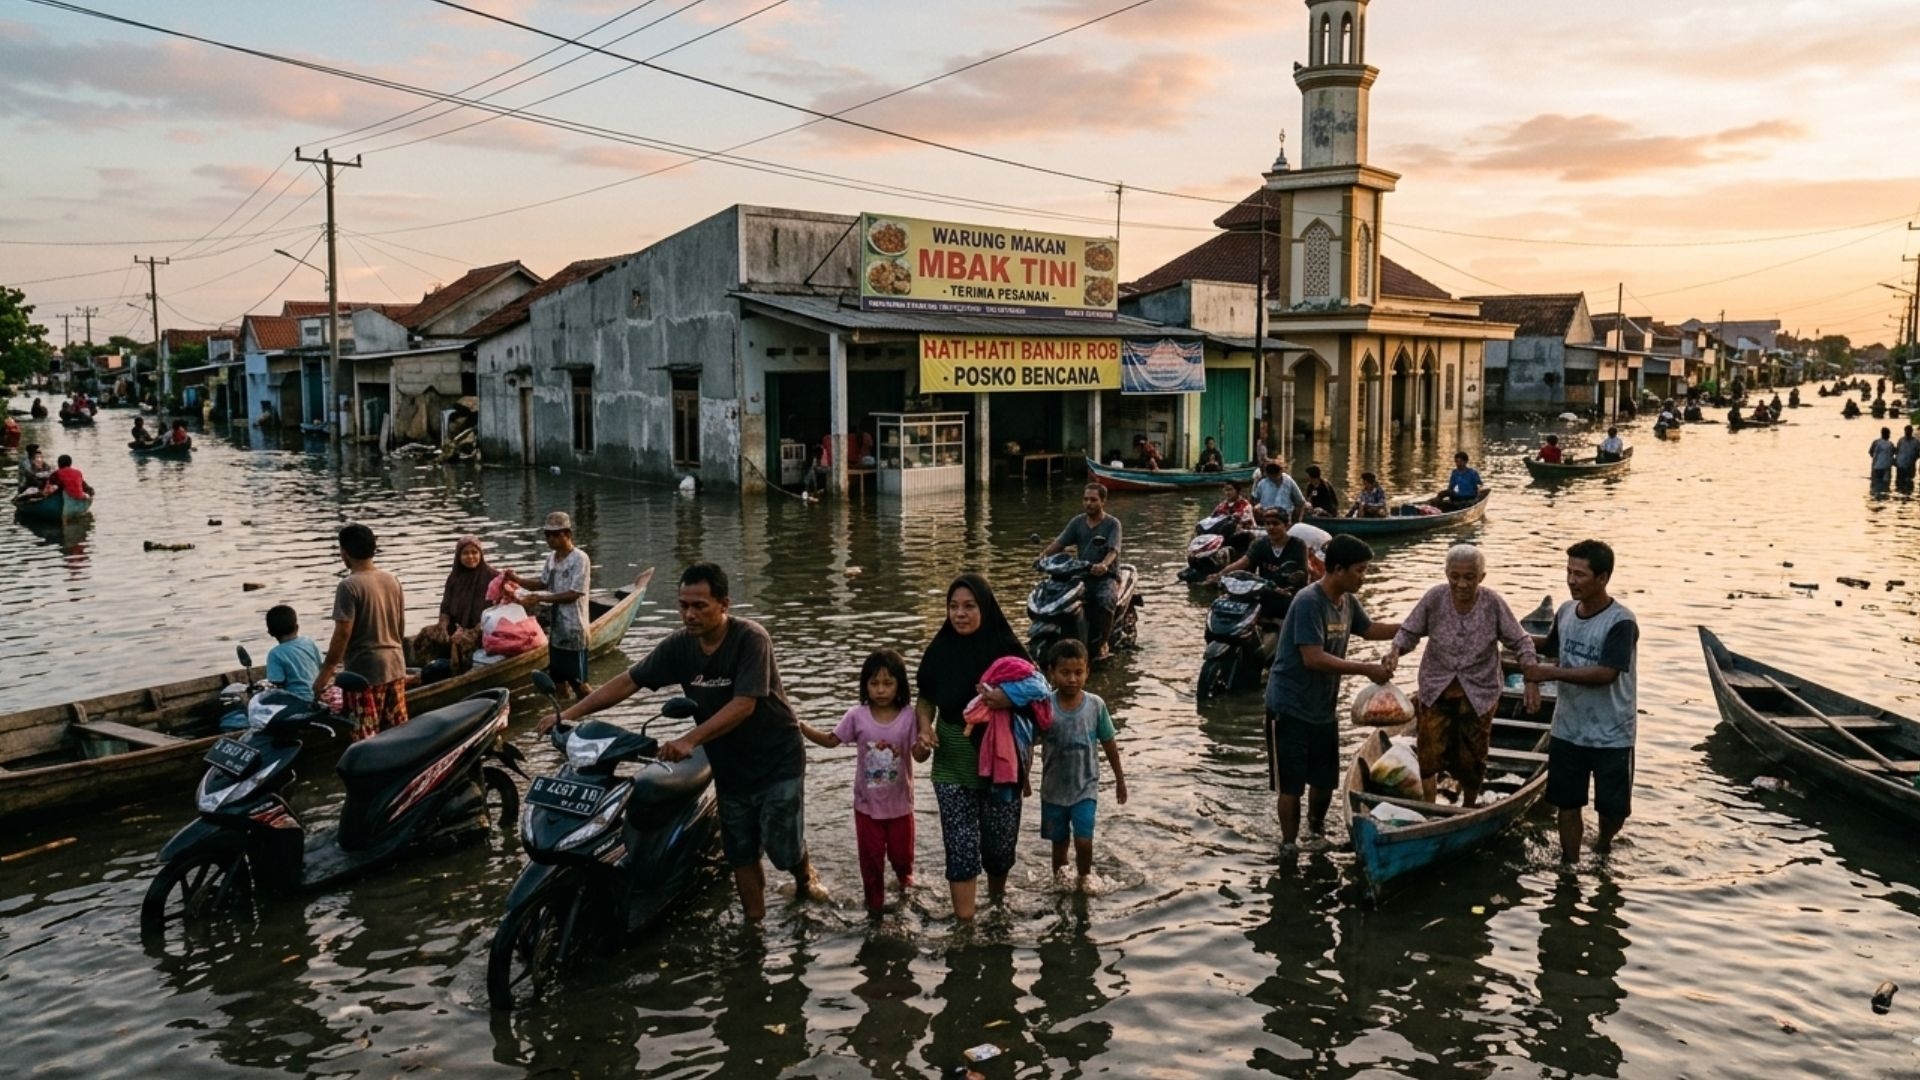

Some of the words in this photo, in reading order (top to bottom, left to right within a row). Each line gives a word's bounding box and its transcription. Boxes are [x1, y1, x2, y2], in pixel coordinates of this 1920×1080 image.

[932, 226, 1006, 250] WARUNG
[1010, 234, 1067, 256] MAKAN
[919, 248, 1010, 284] MBAK
[1020, 257, 1077, 288] TINI
[997, 287, 1050, 302] PESANAN
[1021, 340, 1082, 361] BANJIR
[954, 366, 1017, 387] POSKO
[1021, 366, 1102, 386] BENCANA
